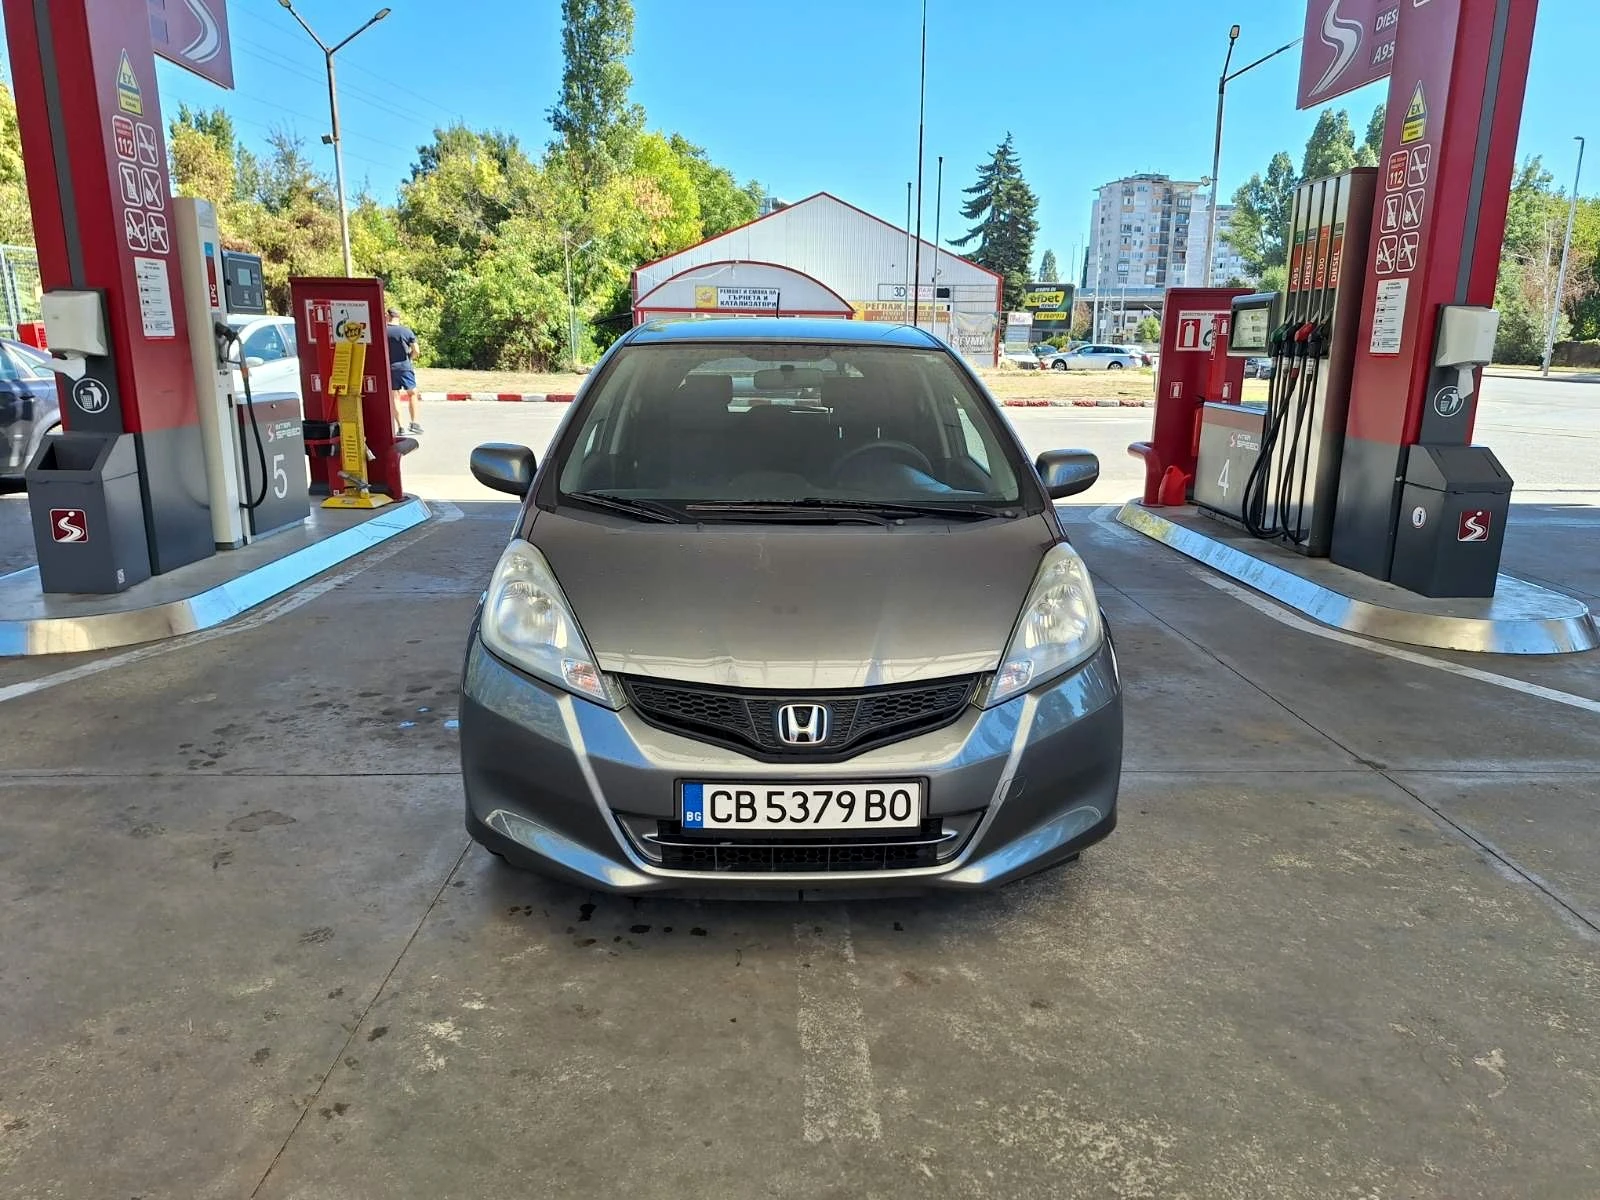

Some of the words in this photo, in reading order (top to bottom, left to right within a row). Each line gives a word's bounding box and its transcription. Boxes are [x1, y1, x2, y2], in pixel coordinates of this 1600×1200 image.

[1372, 41, 1395, 64] A95
[1411, 104, 1421, 115] EX
[118, 137, 134, 155] 112
[1389, 170, 1404, 186] 112
[1317, 258, 1325, 282] A100
[1331, 249, 1340, 282] DIESEL
[894, 287, 906, 297] 3D
[1029, 294, 1060, 303] efbet
[274, 454, 288, 498] 5
[1218, 459, 1230, 497] 4
[686, 811, 702, 821] BG
[710, 790, 757, 823] CB
[766, 791, 856, 823] 5379
[865, 790, 912, 822] BO
